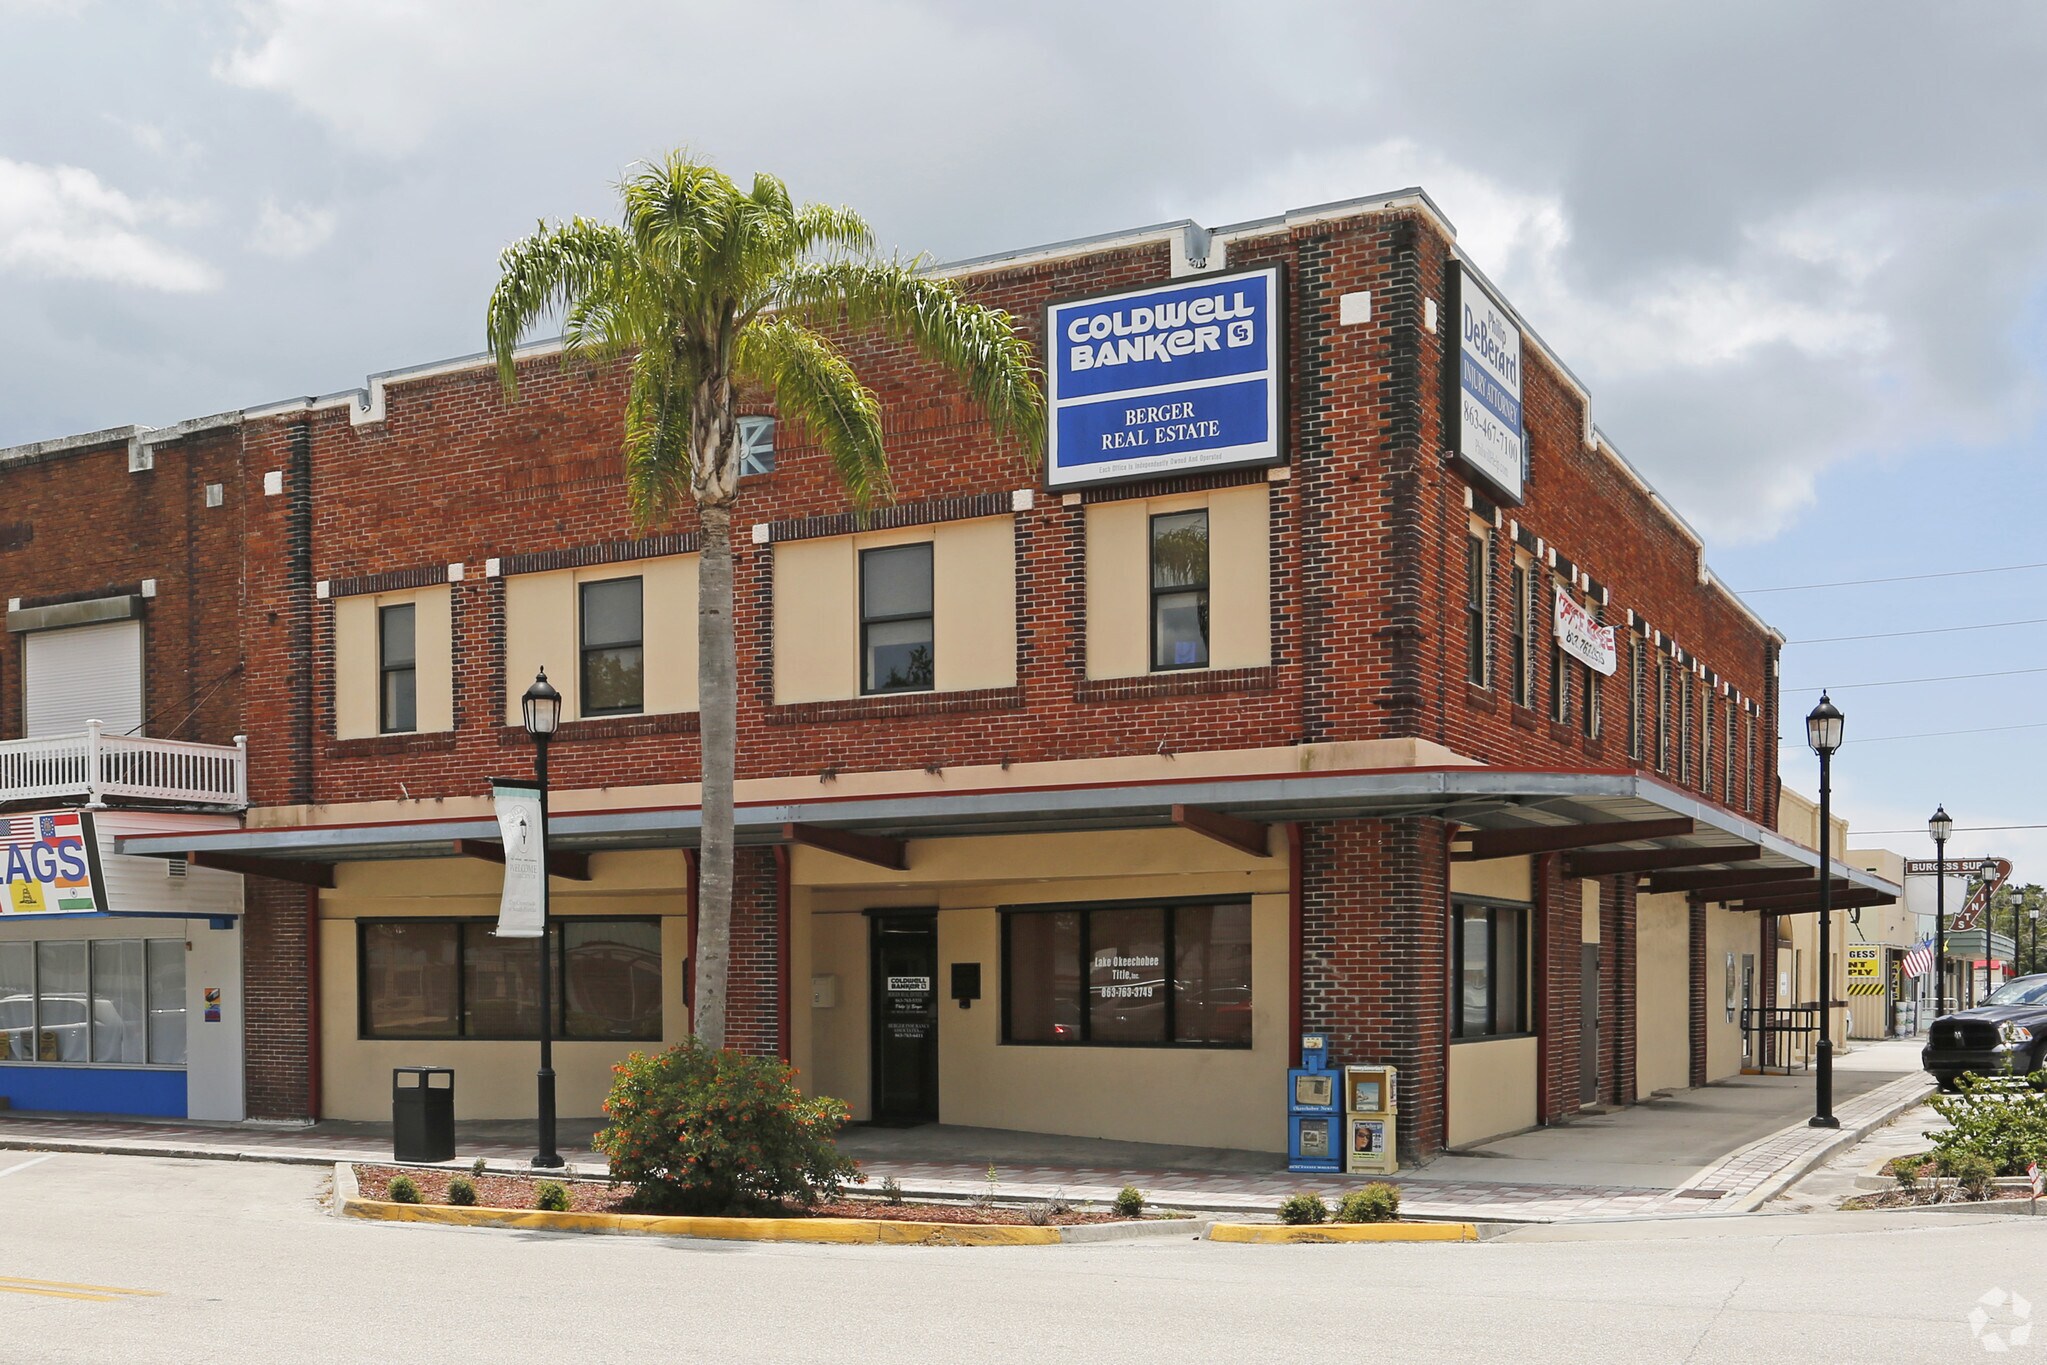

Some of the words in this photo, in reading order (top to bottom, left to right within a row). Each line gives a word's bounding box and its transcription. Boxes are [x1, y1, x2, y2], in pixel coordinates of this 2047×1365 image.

[1464, 359, 1487, 397] INJURY
[1486, 382, 1518, 425] ATTORNEY
[1125, 401, 1195, 426] BERGER
[1101, 429, 1149, 450] REAL
[1154, 419, 1221, 444] ESTATE
[1464, 400, 1518, 463] 863-467-7100
[1098, 466, 1111, 474] Each
[1112, 464, 1127, 472] Office
[0, 838, 86, 885] AGS
[1962, 861, 2000, 870] SUPY
[1094, 956, 1112, 968] Lake
[1113, 955, 1159, 967] Okeechobee
[1101, 986, 1153, 998] 863-763-3749
